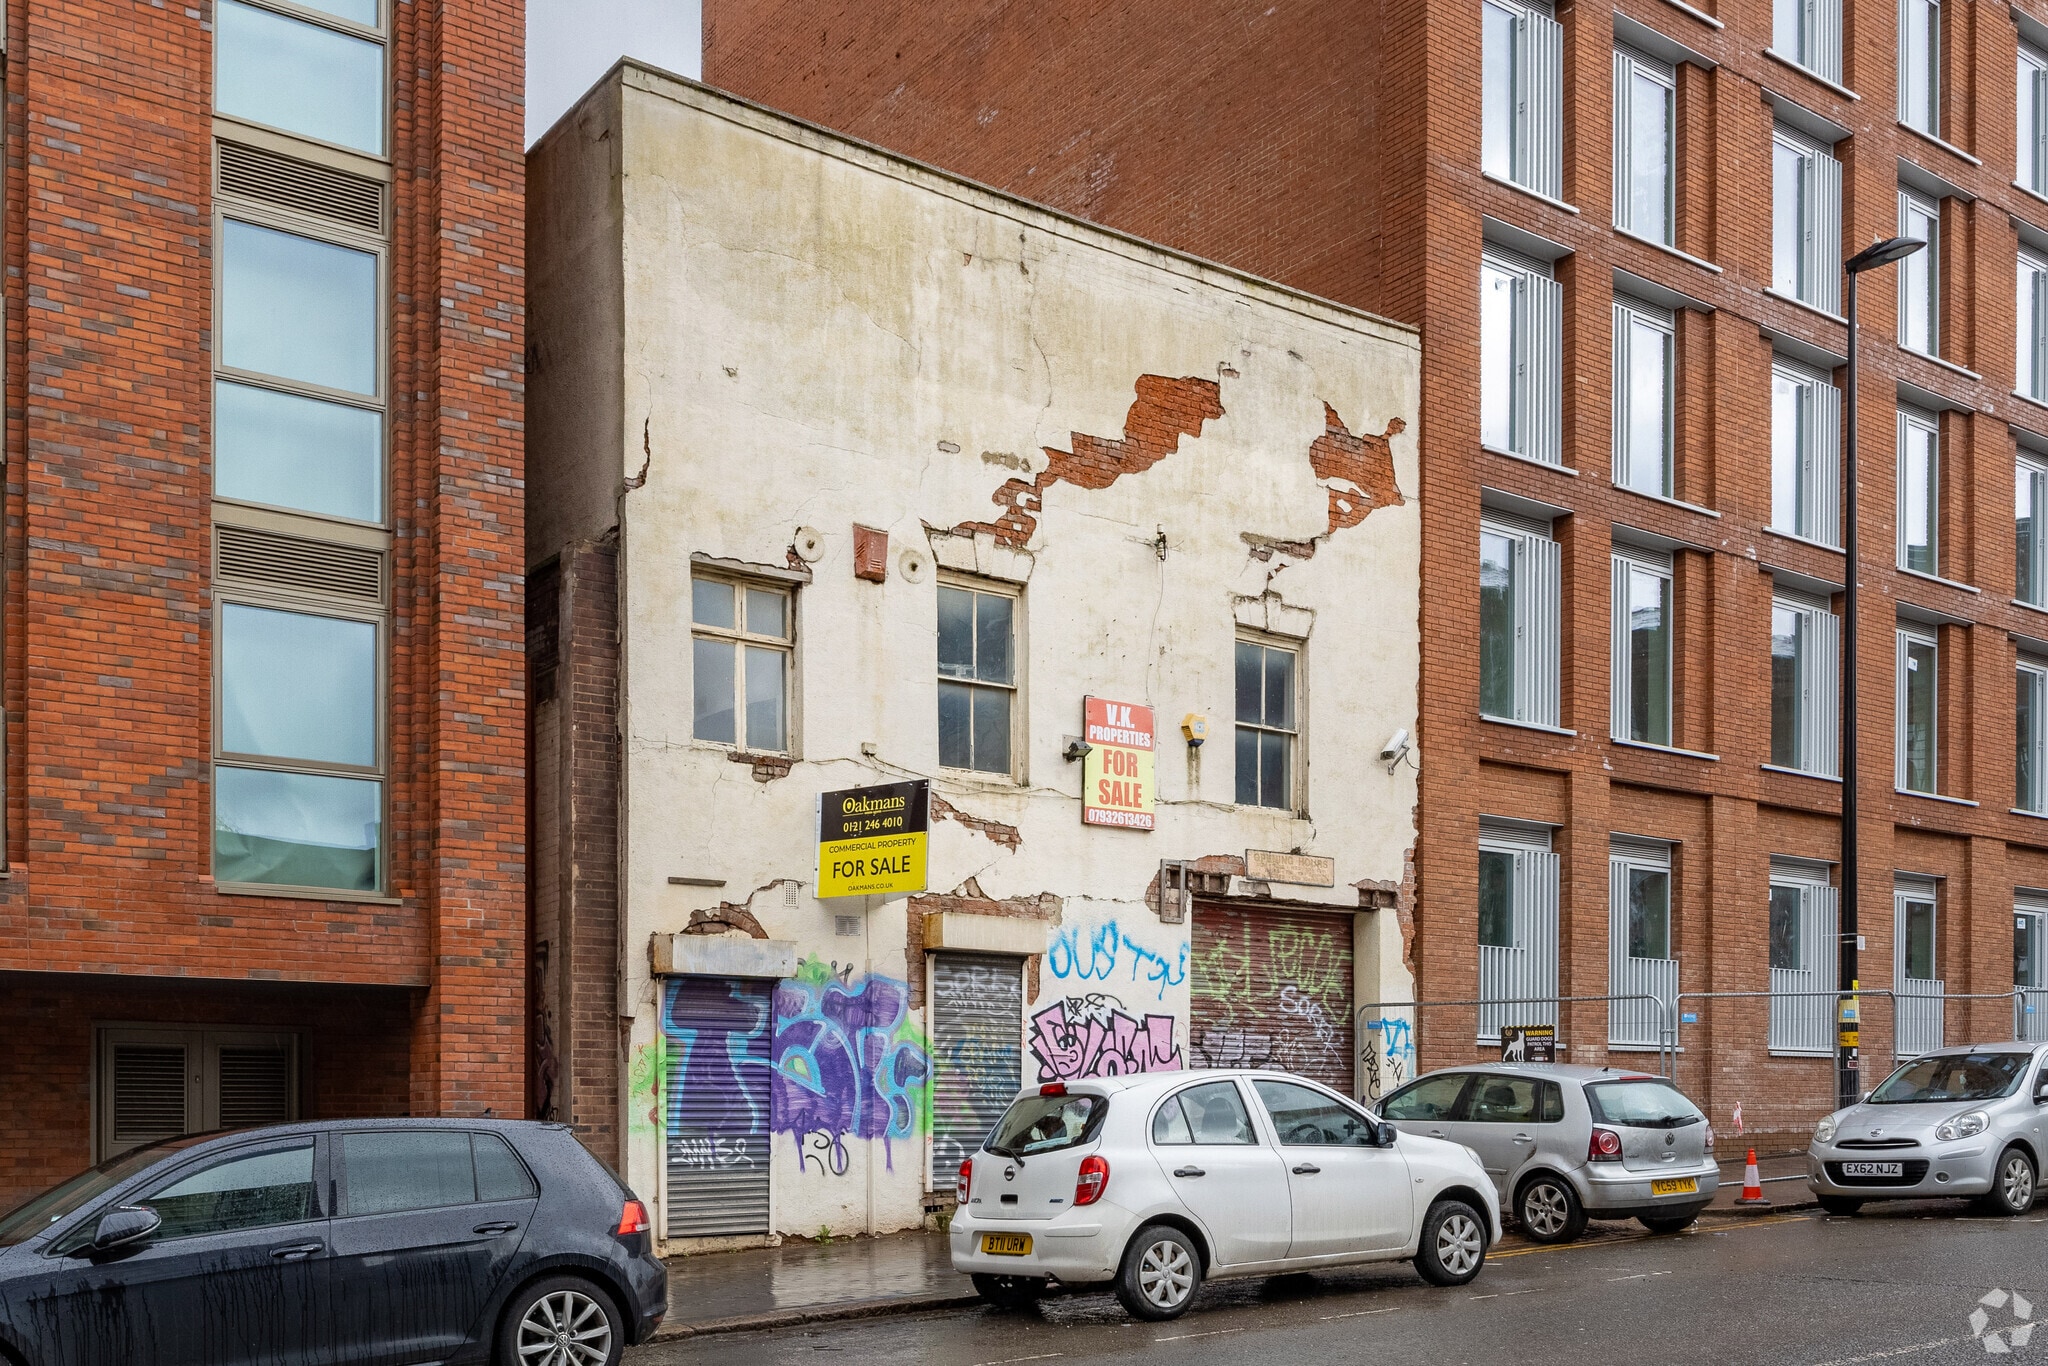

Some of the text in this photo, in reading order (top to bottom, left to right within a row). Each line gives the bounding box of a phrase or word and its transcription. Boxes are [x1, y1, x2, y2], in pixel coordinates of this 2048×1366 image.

[1106, 703, 1135, 729] V.K.
[1089, 725, 1151, 748] PROPERTIES
[1103, 749, 1138, 778] FOR
[1098, 778, 1143, 809] SALE
[842, 796, 905, 814] Oakmans
[843, 816, 903, 833] 0121 246 4010
[1088, 808, 1152, 828] 07932613426
[829, 838, 917, 854] COMMERCIAL PROPERTY
[833, 855, 911, 879] FOR SALE
[1298, 857, 1329, 869] HOURS
[848, 882, 894, 892] OAKMANS.CO.UK
[1846, 1163, 1898, 1174] EX62 NJZ
[1654, 1179, 1694, 1192] YC59 TYK
[1006, 1237, 1026, 1251] URW
